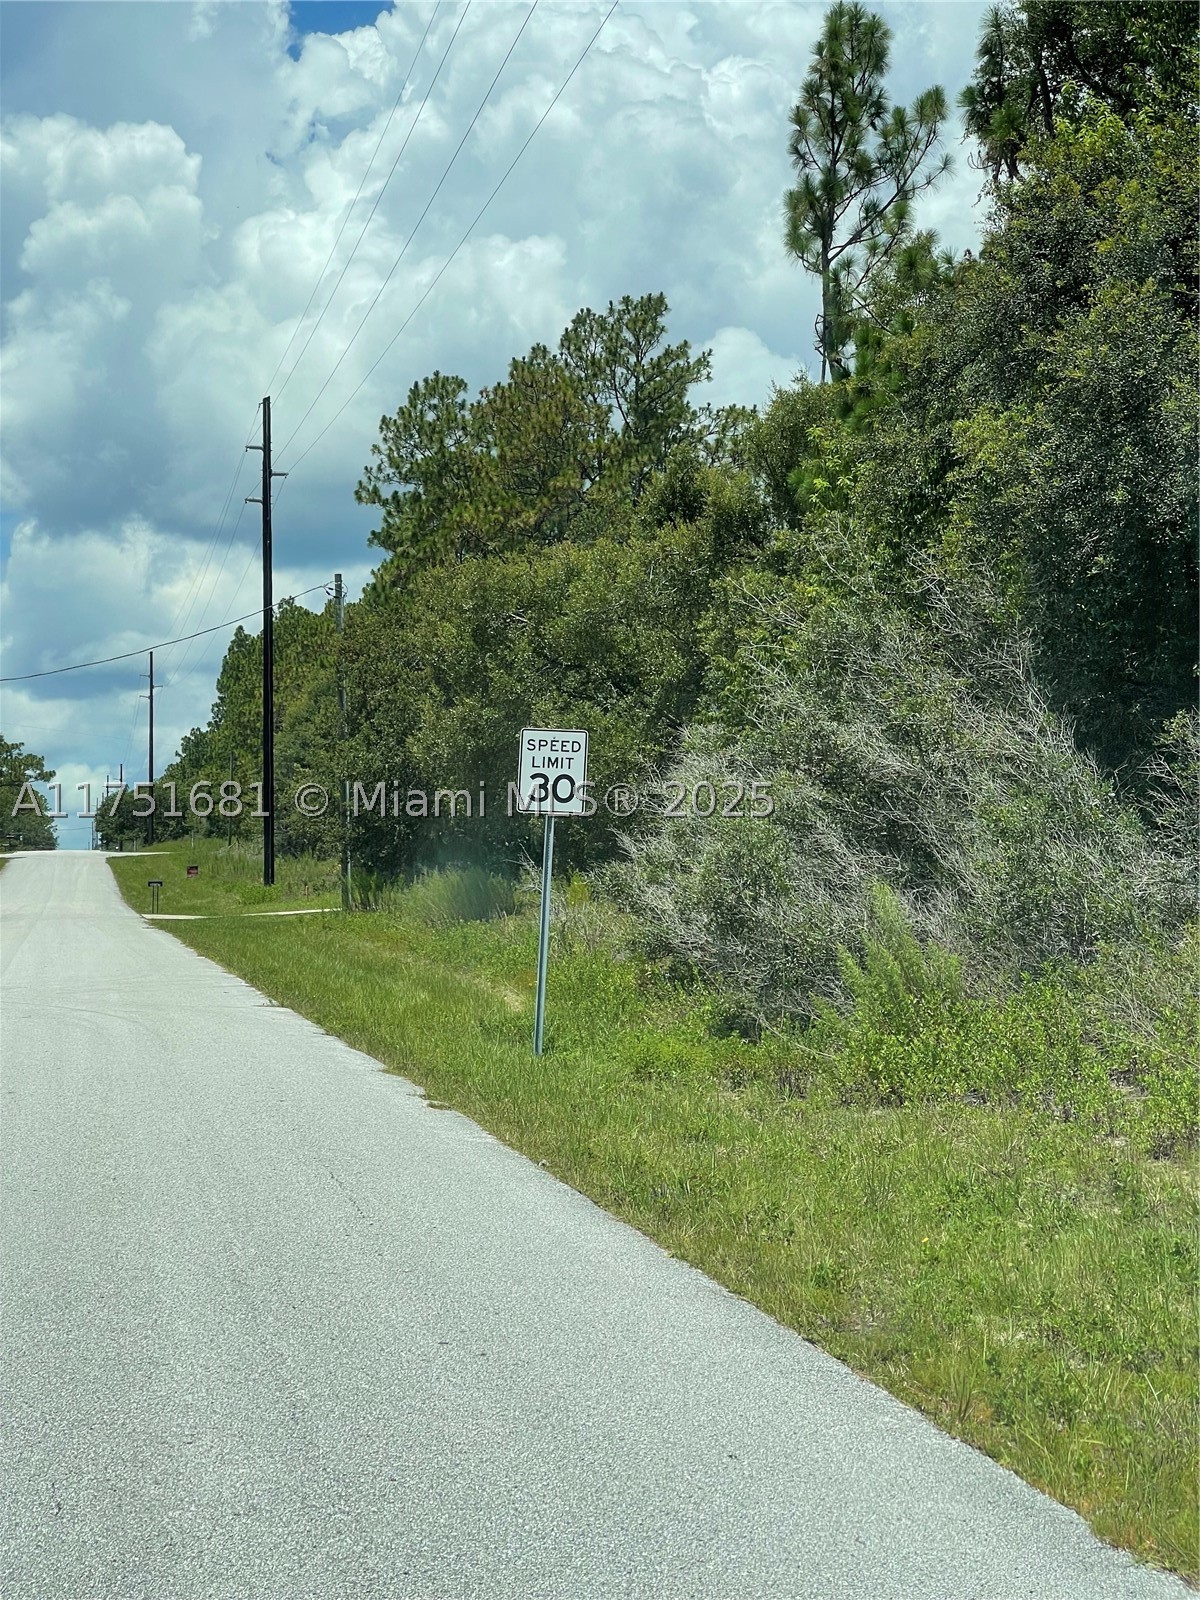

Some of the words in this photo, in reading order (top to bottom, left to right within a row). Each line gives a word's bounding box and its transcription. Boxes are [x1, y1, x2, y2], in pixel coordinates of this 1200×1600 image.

[527, 738, 581, 752] SPEED
[531, 756, 574, 769] LIMIT
[529, 773, 576, 803] 30
